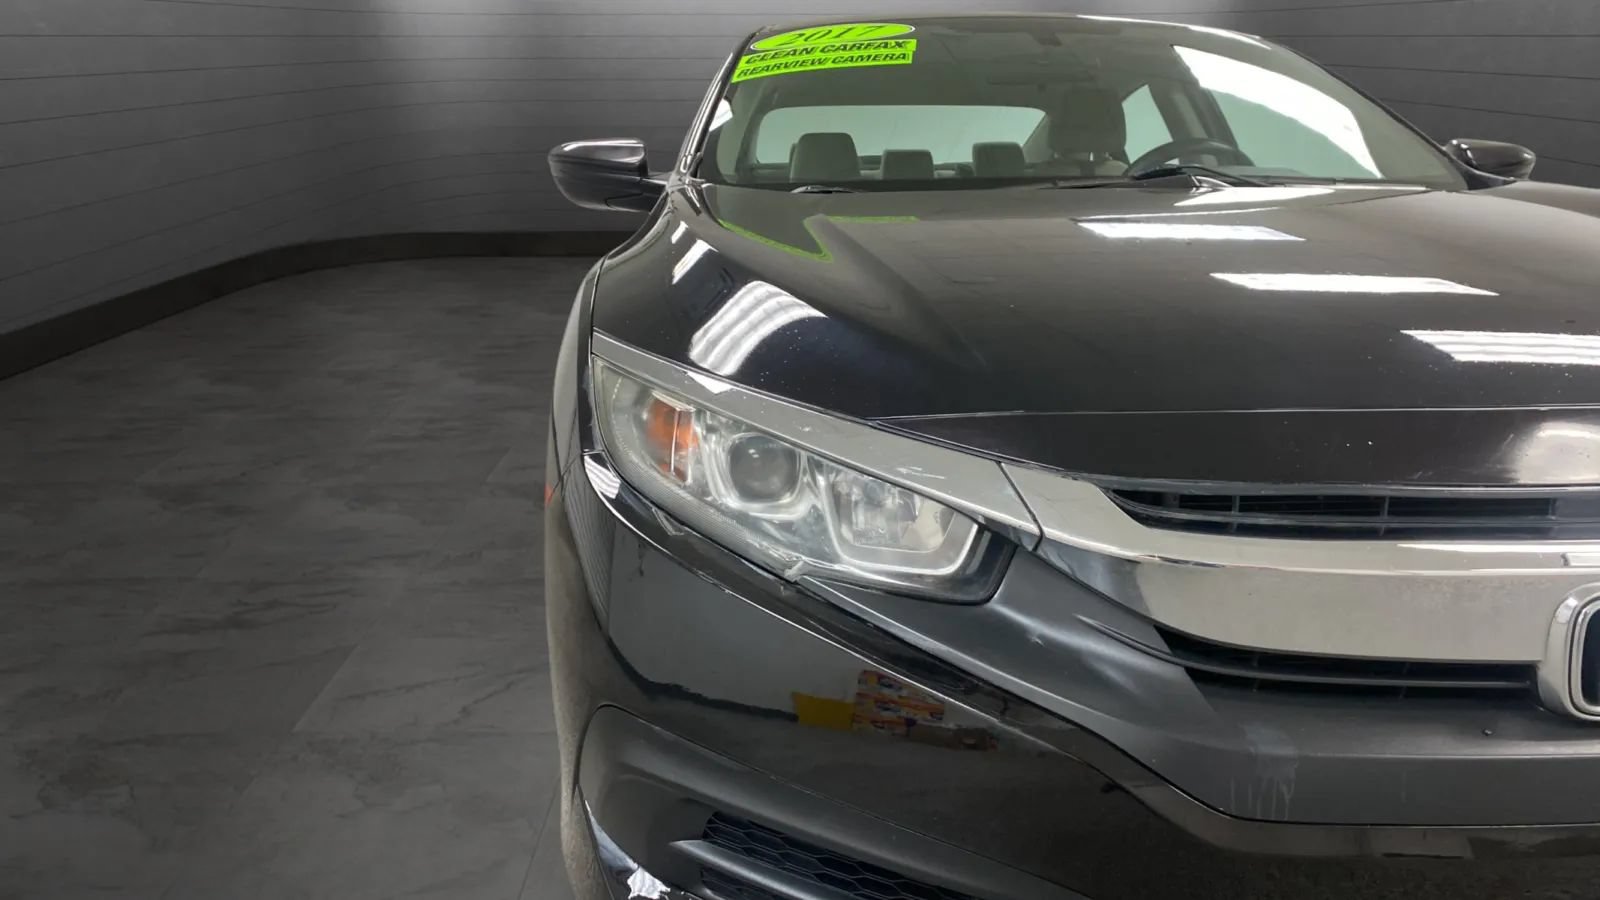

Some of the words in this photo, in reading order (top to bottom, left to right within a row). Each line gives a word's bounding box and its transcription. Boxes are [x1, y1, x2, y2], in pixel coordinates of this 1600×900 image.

[776, 25, 887, 46] 2017
[736, 56, 828, 78] REARVIEW
[831, 52, 907, 65] CAMERA
[745, 47, 817, 65] CLEAN
[819, 40, 907, 53] CARFAX
